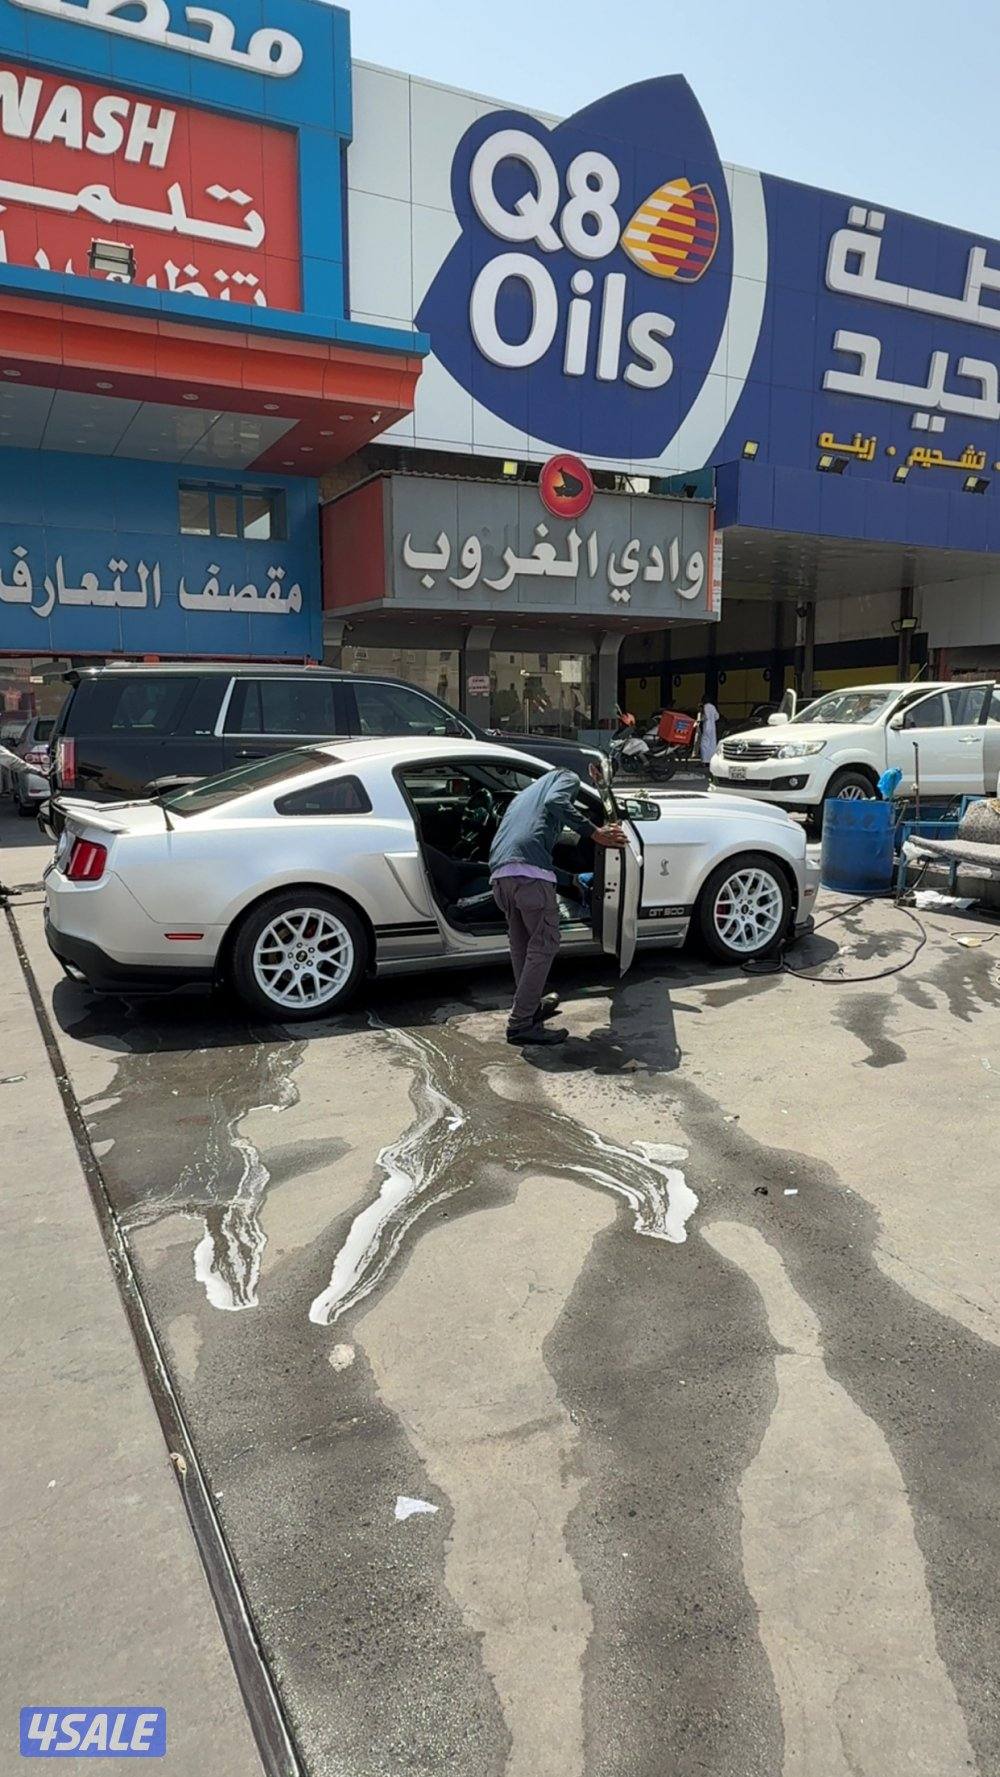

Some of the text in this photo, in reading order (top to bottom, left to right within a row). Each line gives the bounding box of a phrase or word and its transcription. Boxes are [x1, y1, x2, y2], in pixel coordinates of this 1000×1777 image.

[470, 129, 621, 260] Q8
[469, 252, 676, 390] Oils
[179, 564, 303, 614] مقصف
[402, 523, 599, 591] الغروب
[607, 537, 705, 604] وادي
